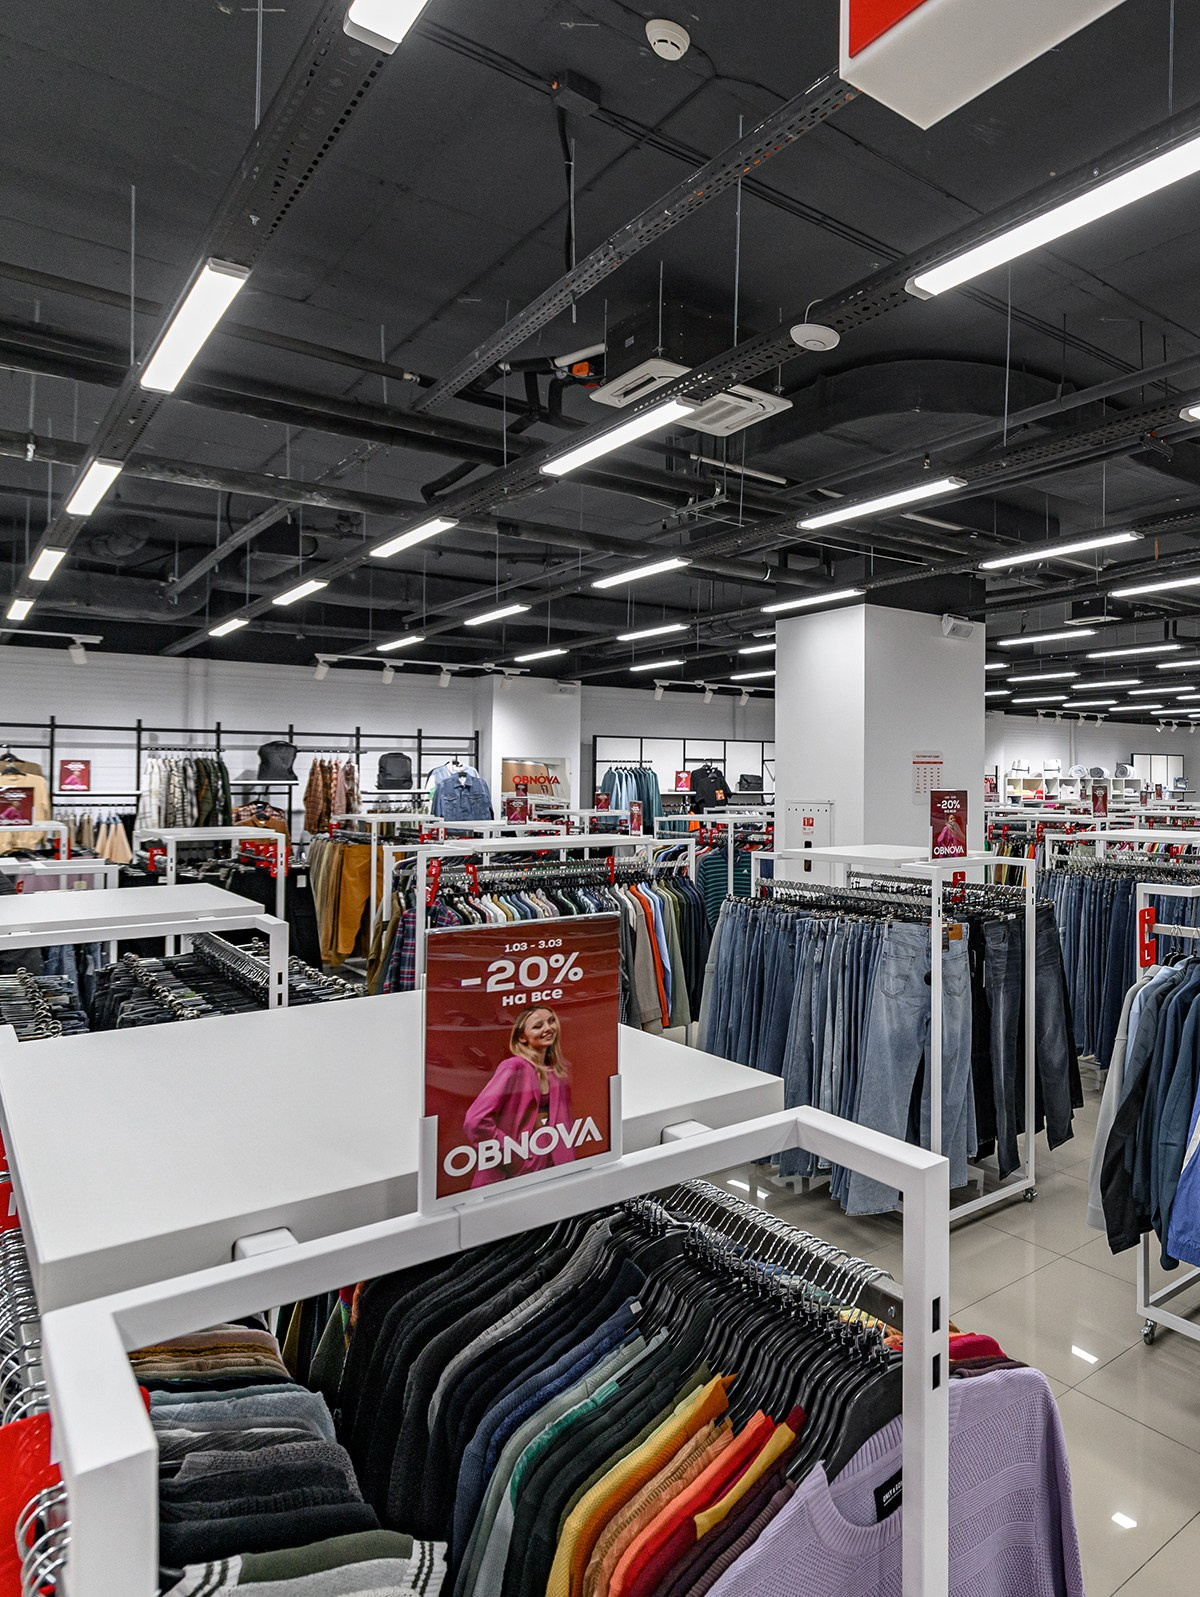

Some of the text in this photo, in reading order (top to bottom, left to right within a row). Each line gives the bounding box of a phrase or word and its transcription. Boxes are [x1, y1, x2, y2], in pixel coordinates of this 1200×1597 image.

[937, 799, 961, 809] -20%
[1145, 910, 1150, 920] L
[504, 941, 528, 953] 1.03
[538, 938, 563, 950] 3.03
[1144, 949, 1151, 961] L
[460, 951, 584, 993] -20%
[502, 988, 563, 1007] на все
[443, 1116, 603, 1177] OBNOVA
